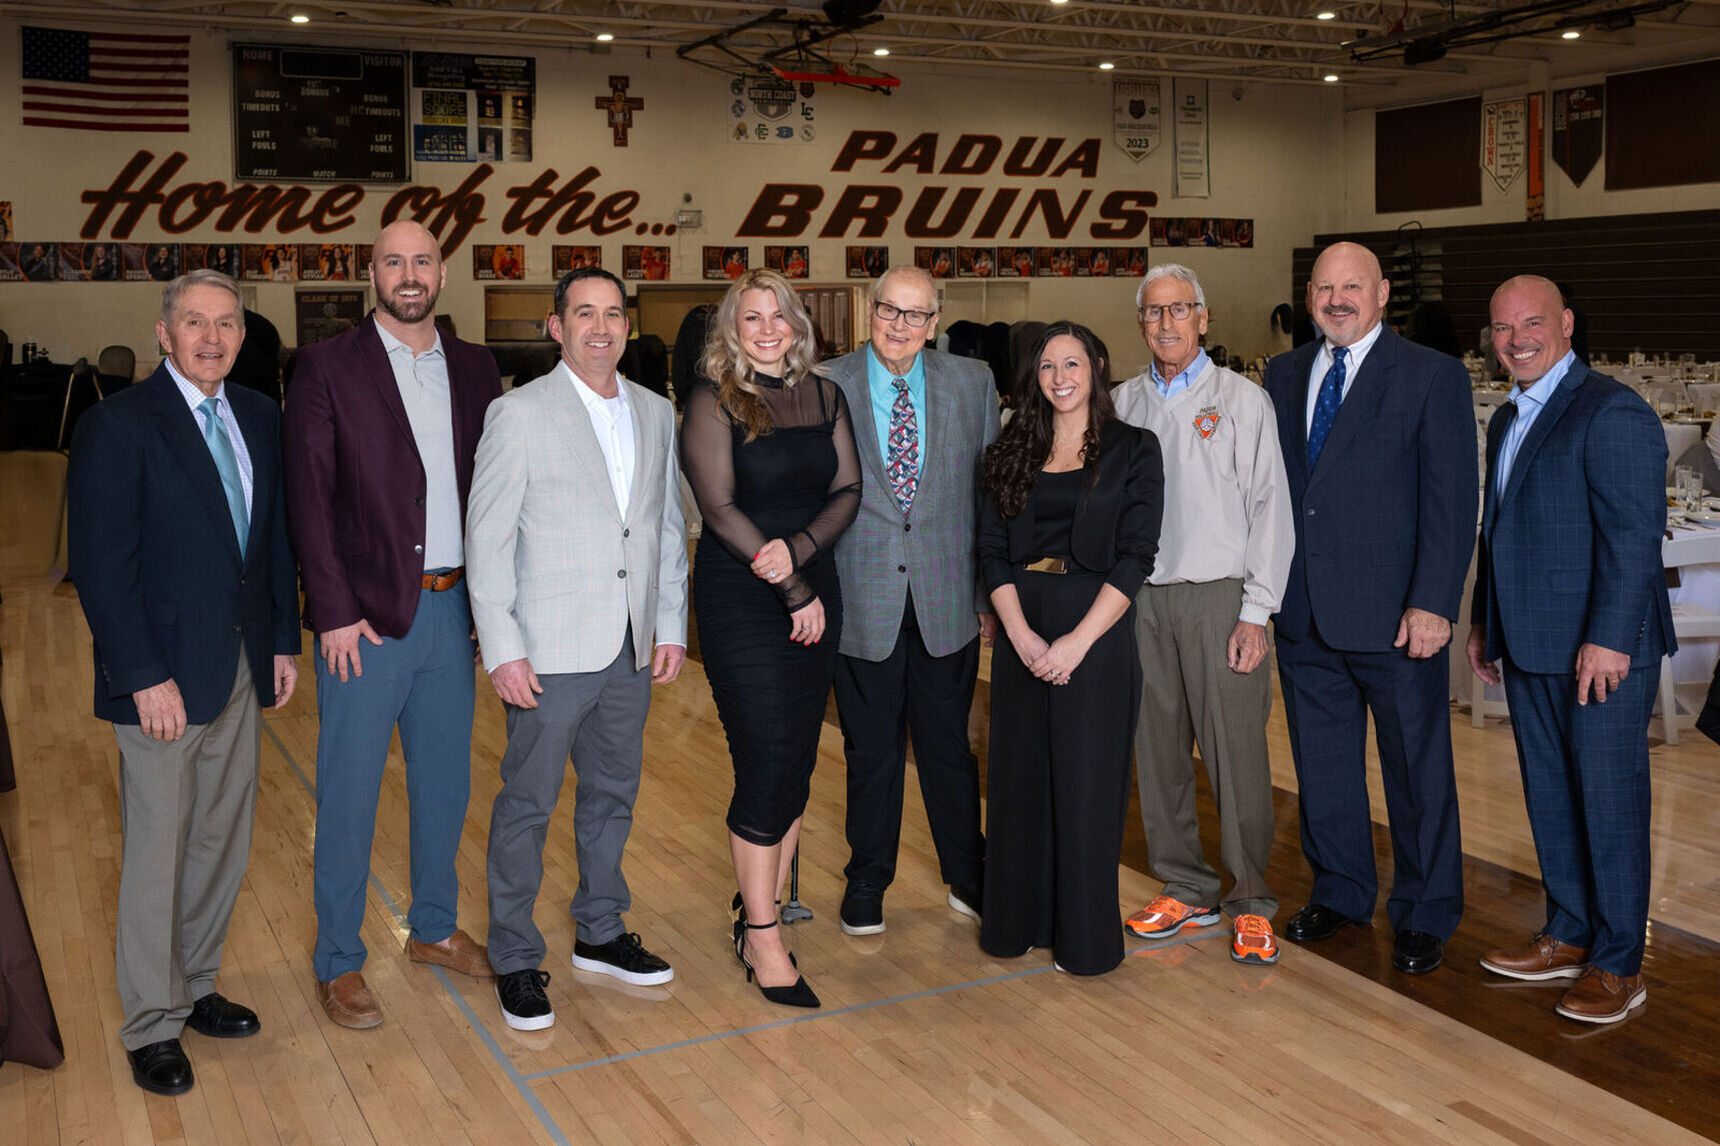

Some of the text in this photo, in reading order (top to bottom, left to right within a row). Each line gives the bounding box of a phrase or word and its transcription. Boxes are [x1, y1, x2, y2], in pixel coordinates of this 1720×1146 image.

[243, 49, 273, 61] HOME
[364, 55, 402, 67] VISITOR
[254, 88, 281, 99] BONUS
[363, 93, 389, 103] BONUS
[423, 92, 466, 105] FINAL
[241, 102, 281, 112] TIMEOUTS
[365, 106, 402, 117] TIMEOUTS
[423, 103, 466, 116] SCORE
[251, 129, 271, 139] LEFT
[374, 133, 393, 143] LEFT
[251, 141, 277, 151] FOULS
[369, 144, 393, 153] FOULS
[1126, 137, 1150, 149] 2023
[829, 130, 1101, 178] PADUA
[252, 168, 278, 177] POINTS
[312, 169, 337, 178] MATCH
[370, 170, 395, 179] POINTS
[80, 149, 366, 240] Home
[379, 163, 495, 261] of
[734, 183, 1158, 239] BRUINS
